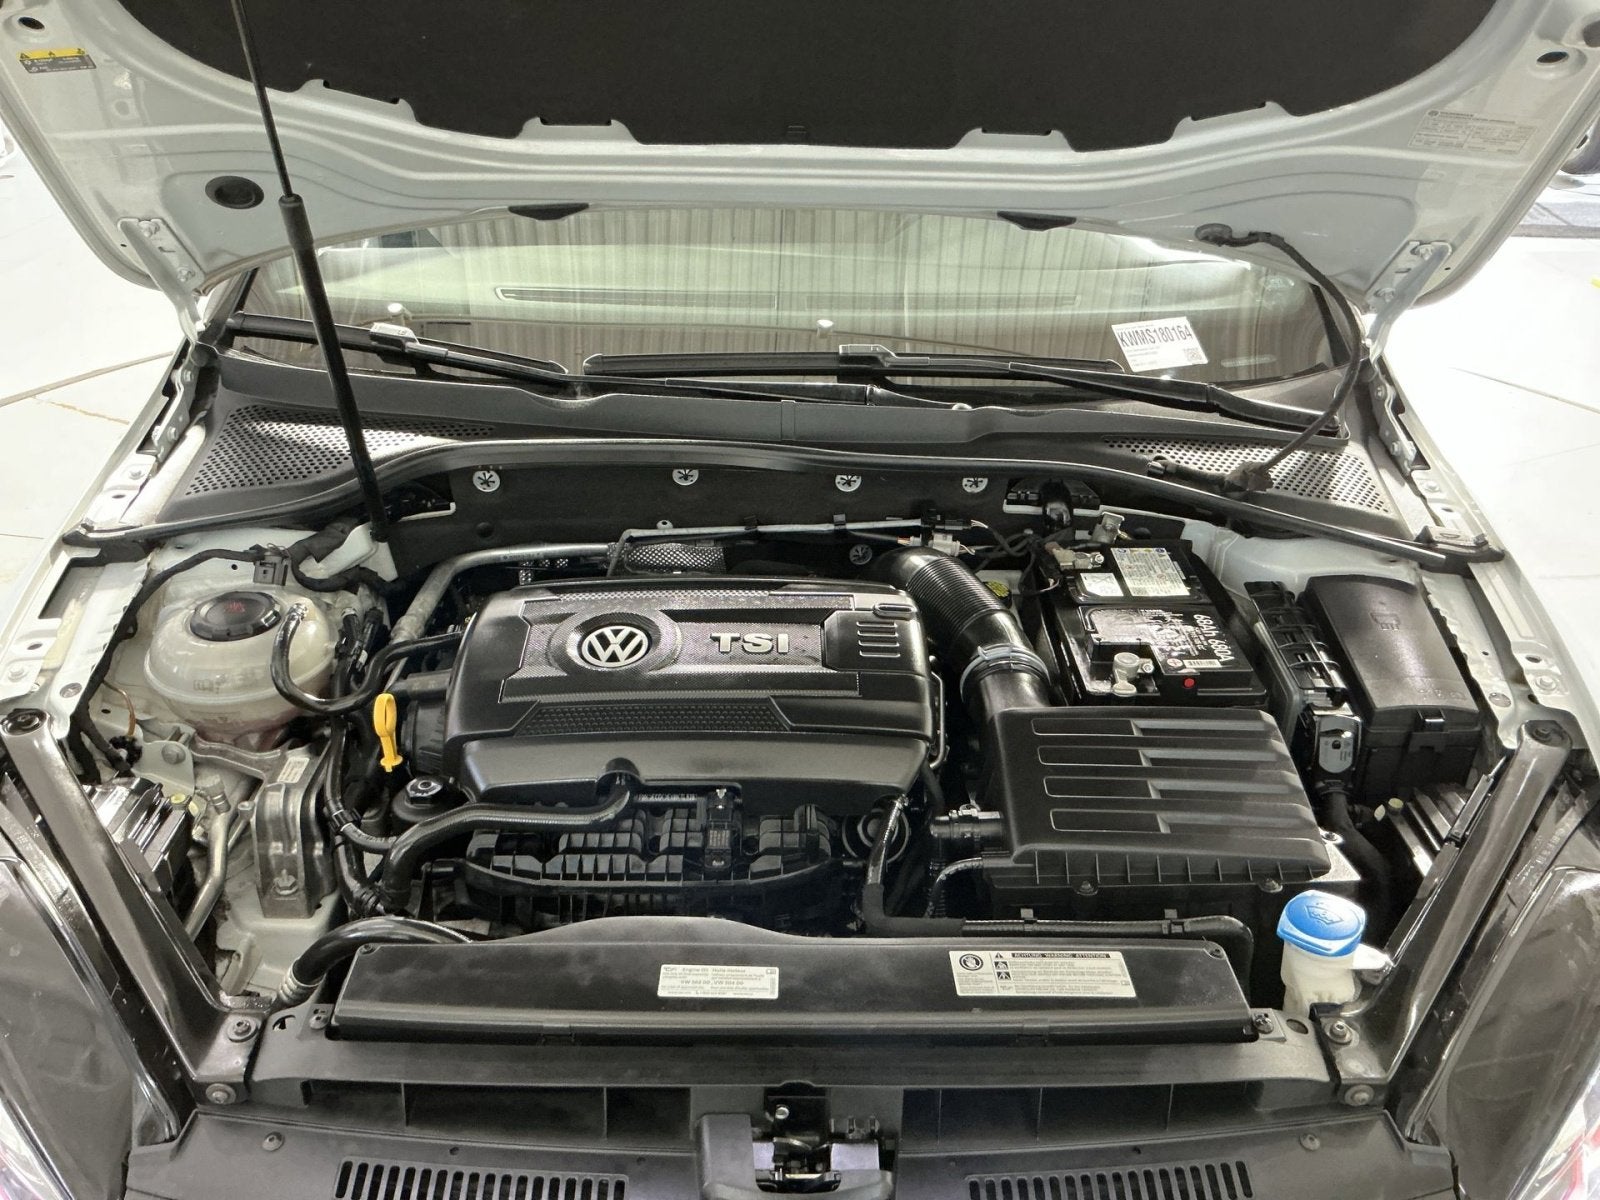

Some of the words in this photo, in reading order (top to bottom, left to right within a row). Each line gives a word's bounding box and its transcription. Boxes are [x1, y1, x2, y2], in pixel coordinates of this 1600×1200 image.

[1117, 324, 1193, 347] KWMS180164
[710, 633, 789, 654] TSI
[1193, 614, 1219, 637] 68Ah
[1208, 639, 1235, 661] 680A
